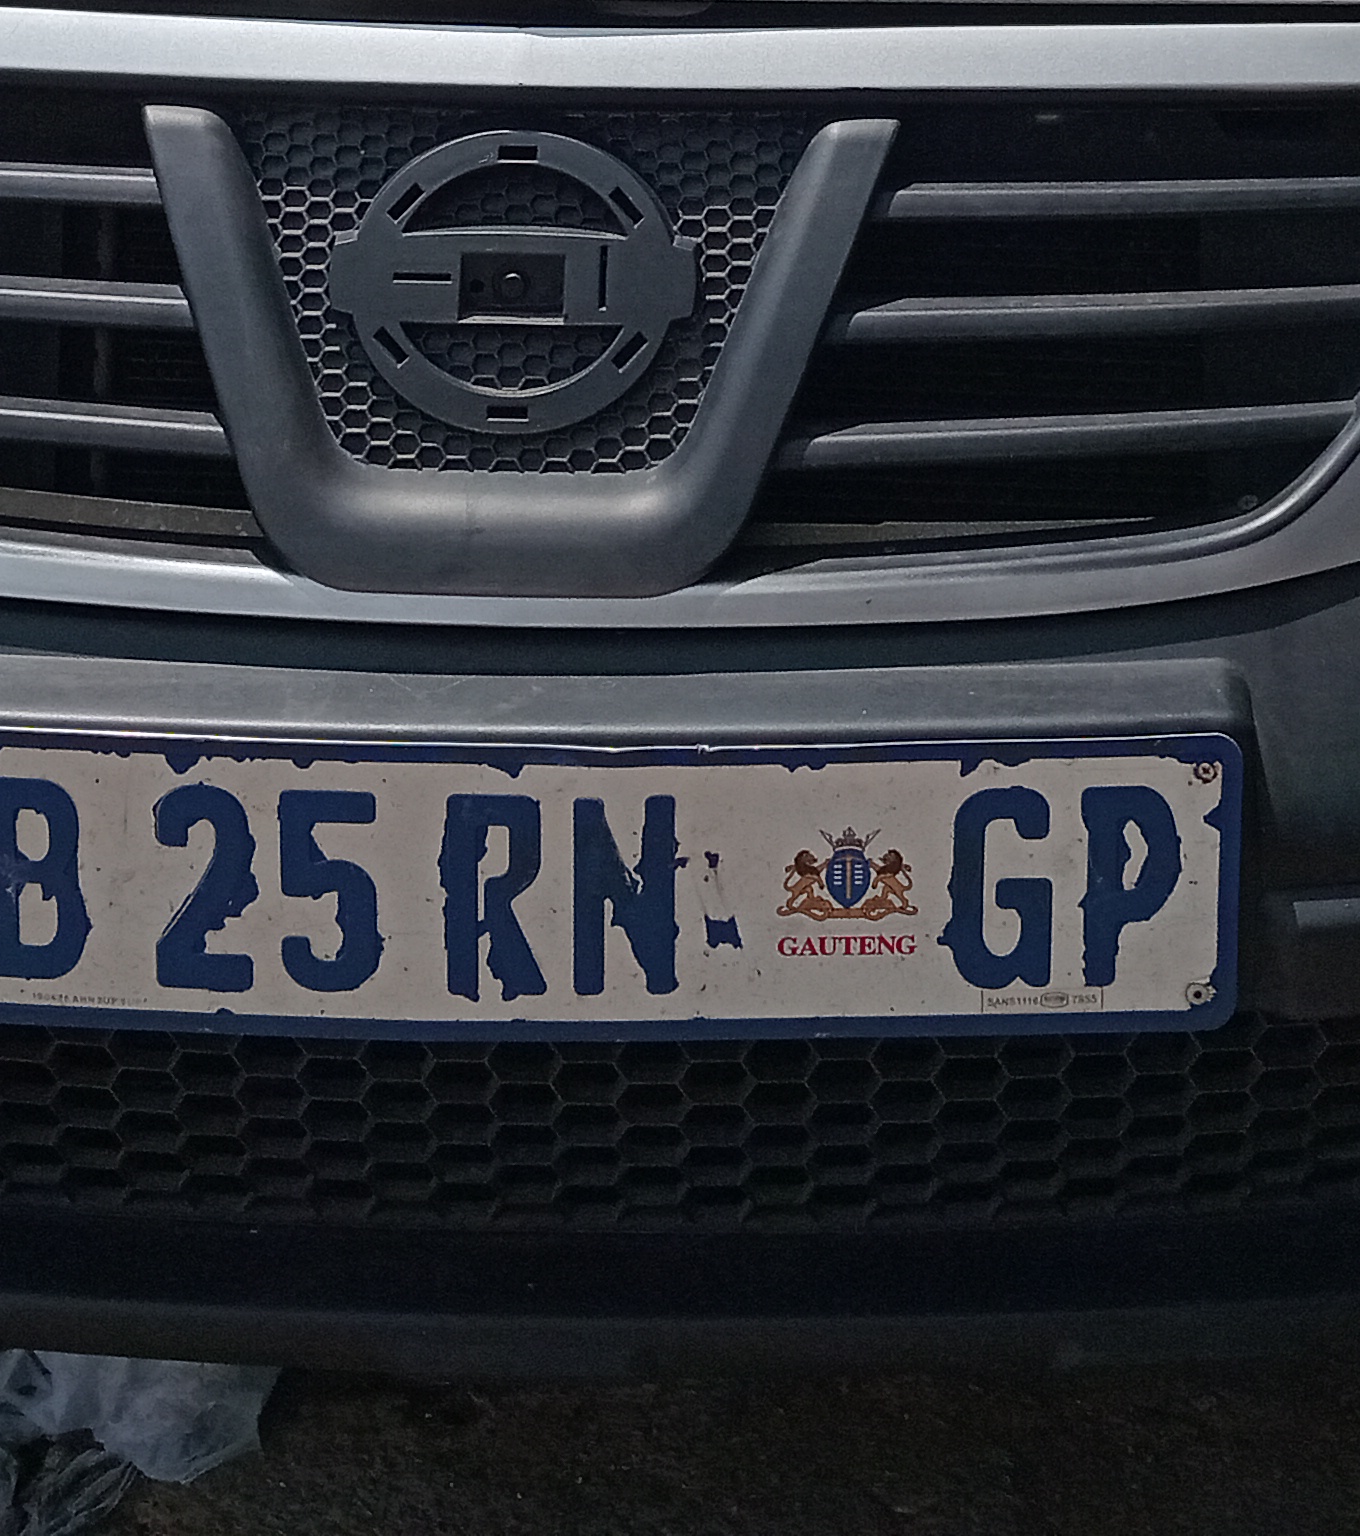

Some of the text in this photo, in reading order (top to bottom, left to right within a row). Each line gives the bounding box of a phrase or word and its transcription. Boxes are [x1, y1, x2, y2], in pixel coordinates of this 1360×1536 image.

[151, 780, 385, 994] 25
[438, 792, 682, 1002] RN
[937, 784, 1182, 990] GP
[776, 934, 918, 957] GAUTENG
